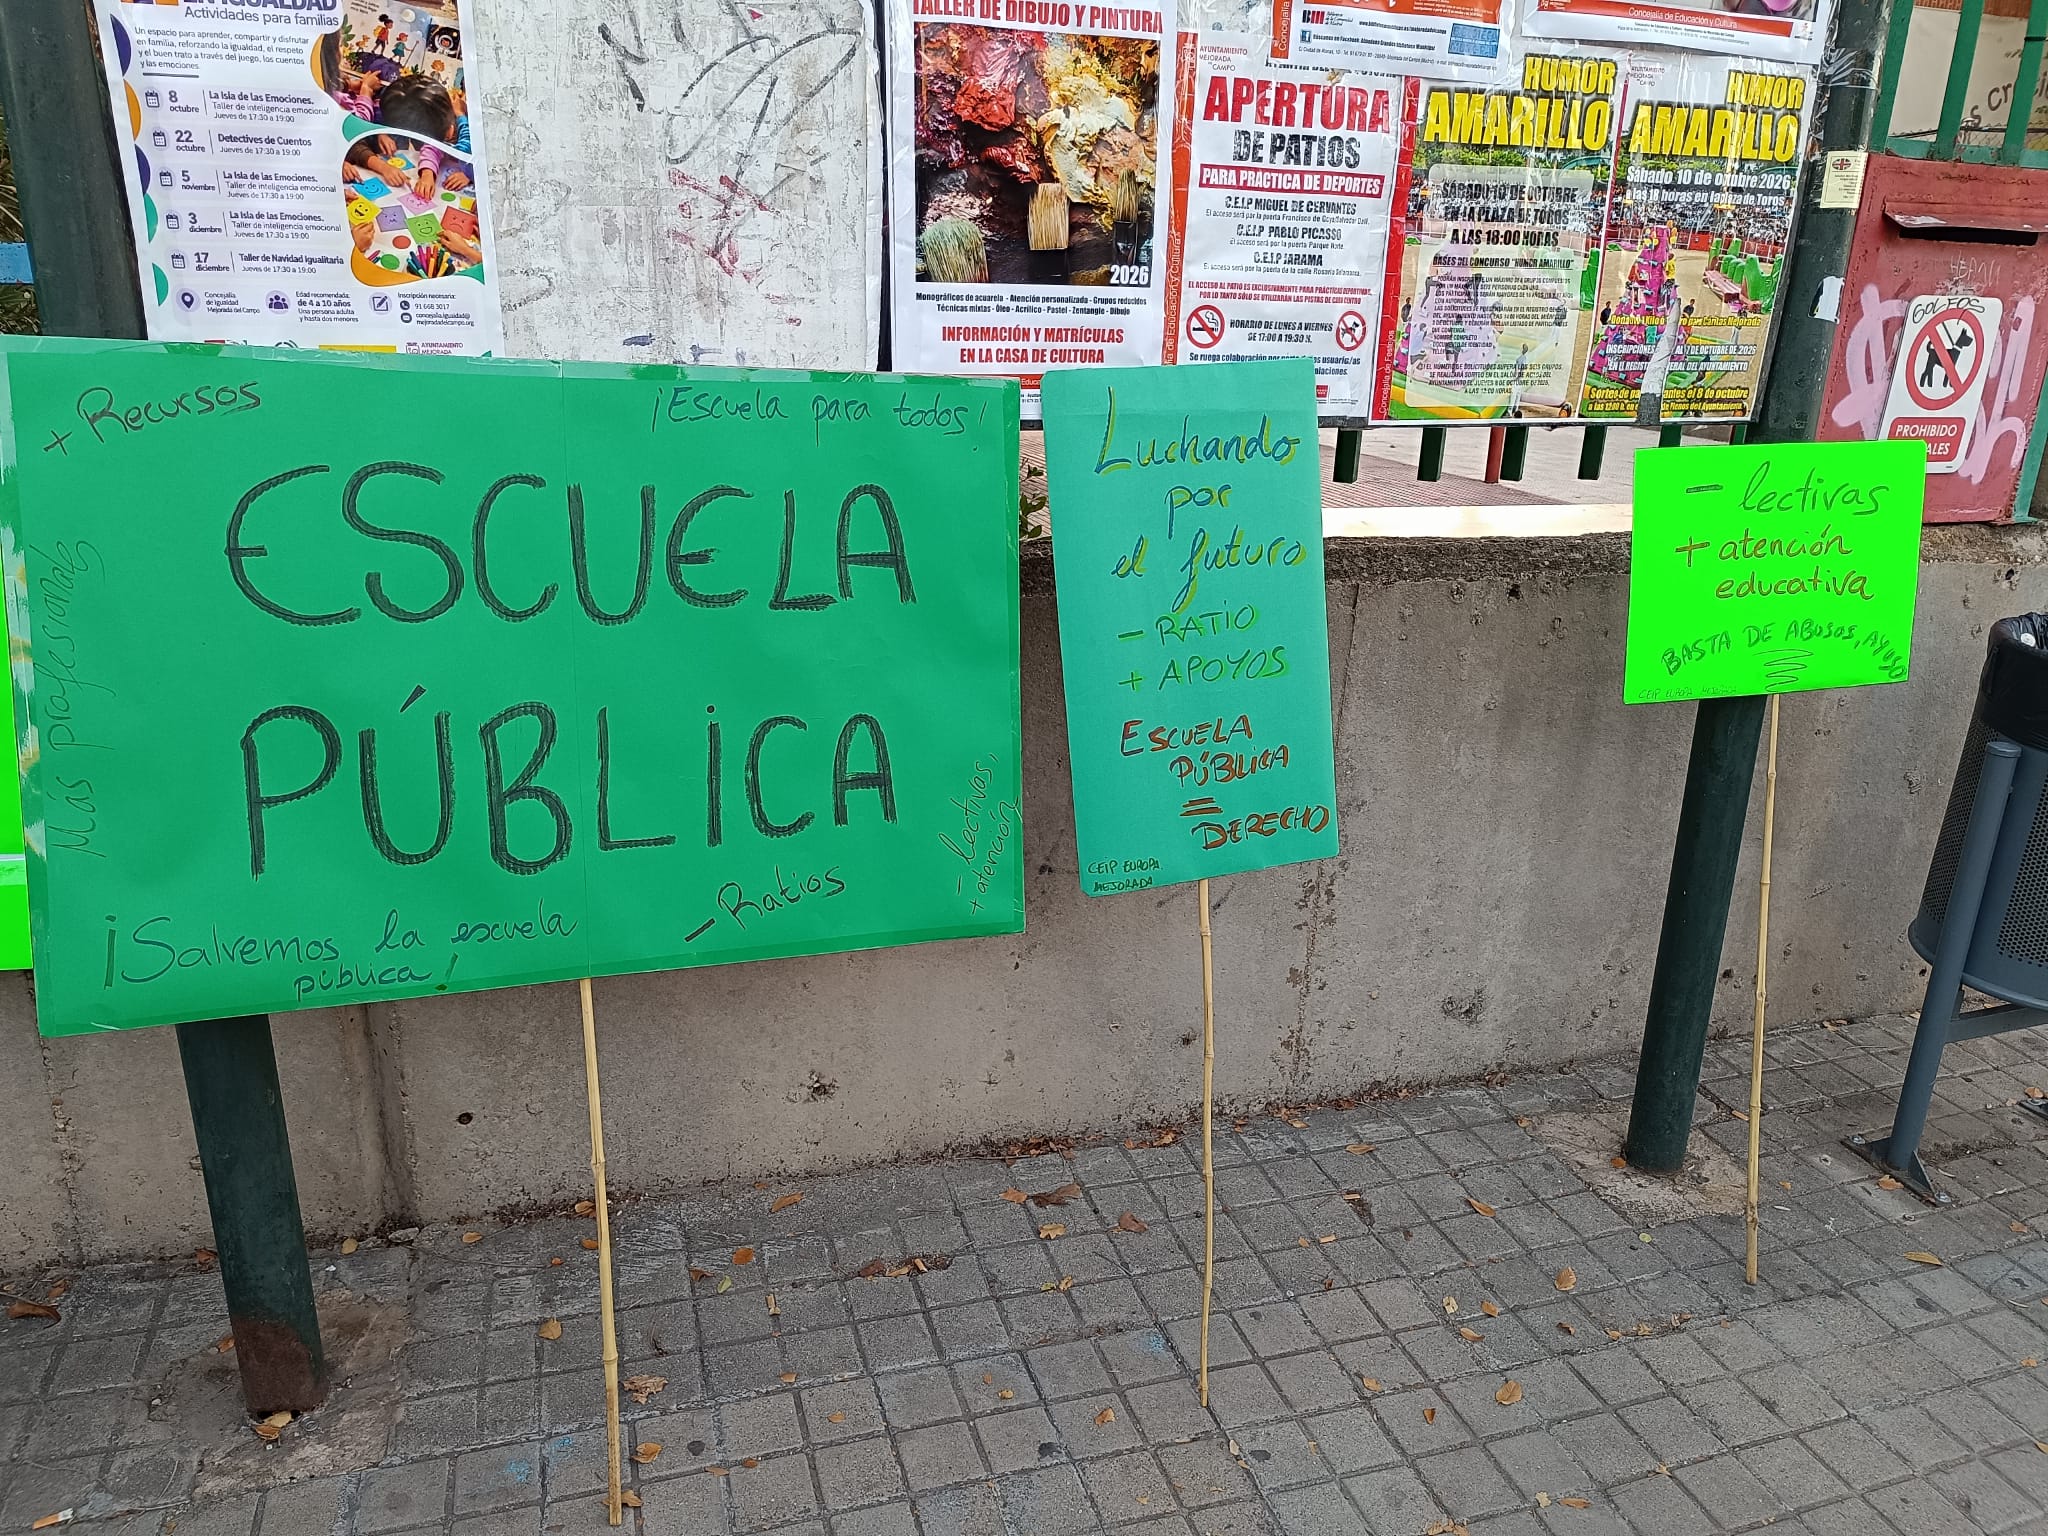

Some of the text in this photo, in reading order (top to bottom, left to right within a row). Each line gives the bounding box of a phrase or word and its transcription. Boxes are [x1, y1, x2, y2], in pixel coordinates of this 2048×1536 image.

[185, 6, 339, 26] Actividades para familias
[980, 0, 1001, 20] DE
[1005, 0, 1070, 27] DIBUJO
[1075, 5, 1086, 27] Y
[1090, 6, 1163, 34] PINTURA
[1664, 12, 1673, 21] de
[1674, 11, 1708, 25] Educación
[1709, 17, 1714, 27] y
[1714, 18, 1737, 29] Cultura
[1200, 46, 1248, 55] AYUNTAMIENTO
[1524, 54, 1616, 95] HUMOR
[168, 90, 178, 102] 8
[208, 91, 219, 99] La
[221, 91, 235, 100] Isla
[237, 92, 249, 101] de
[250, 93, 263, 101] las
[1726, 70, 1806, 110] HUMOR
[170, 105, 199, 113] octubre
[1203, 75, 1390, 134] APERTURA
[1423, 91, 1611, 152] AMARILLO
[1628, 104, 1798, 163] AMARILLO
[175, 130, 193, 142] 22
[176, 144, 205, 152] octubre
[218, 133, 312, 146] Detectives de Cuentos
[1233, 129, 1360, 169] DE PATIOS
[182, 170, 190, 182] 5
[182, 183, 215, 191] noviembre
[1202, 167, 1381, 195] PARA PRÁCTICA DE DEPORTES
[1626, 165, 1674, 185] Sábado
[1676, 169, 1691, 185] 10
[1694, 169, 1712, 186] de
[1758, 173, 1791, 190] 2026
[189, 212, 197, 224] 3
[1255, 198, 1289, 212] MIGUEL
[1291, 199, 1304, 213] DE
[1306, 200, 1357, 215] CERVANTES
[1268, 225, 1299, 239] PABLO
[1301, 227, 1342, 241] PICASSO
[1450, 228, 1559, 247] A LAS 18:00 HORAS
[194, 252, 209, 263] 17
[196, 264, 230, 272] diciembre
[238, 253, 344, 265] Taller de Navidad Igualitaria
[1109, 264, 1150, 285] 2026
[916, 292, 1147, 306] Monográficos de acuarela Atención personalizada Grupos reducidos
[937, 303, 968, 313] Técnicas
[969, 304, 991, 313] mixtas
[1047, 305, 1067, 314] Pastel
[1072, 305, 1104, 316] Zentangle
[1109, 306, 1130, 317] Dibujo
[1912, 297, 1985, 325] GOLFOS
[942, 324, 1124, 344] INFORMACIÓN Y MATRÍCULAS
[1263, 320, 1273, 330] DE
[1274, 320, 1297, 331] LUNES
[1298, 321, 1304, 331] A
[1304, 321, 1333, 332] VIERNES
[960, 348, 1105, 364] EN LA CASA DE CULTURA
[1696, 389, 1703, 399] 8
[1716, 388, 1749, 399] octubre
[76, 381, 261, 443] Recursos
[651, 387, 988, 452] ¡Escuela para todos!
[1094, 386, 1303, 476] Luchando
[1895, 424, 1958, 438] PROHIBIDO
[1739, 460, 1889, 516] lectivas
[1163, 481, 1233, 541] por
[224, 458, 918, 627] ESCUELA
[1719, 523, 1853, 561] atención
[1111, 525, 1309, 614] el futuro
[1715, 566, 1874, 600] educativa
[1154, 599, 1259, 648] RATIO
[29, 540, 117, 751] profesionales
[1661, 630, 1732, 676] BASTA
[1743, 622, 1776, 648] DE
[1158, 645, 1292, 691] APOYOS
[1120, 713, 1254, 757] ESCUELA
[240, 683, 899, 880] PÚBLICA
[1191, 804, 1331, 850] DERECHO
[972, 796, 1024, 895] atención
[1087, 859, 1118, 875] CEIP
[716, 863, 847, 931] Ratios
[1093, 876, 1153, 893] MEJORADA
[103, 897, 579, 991] ¡Salvemos la escuela
